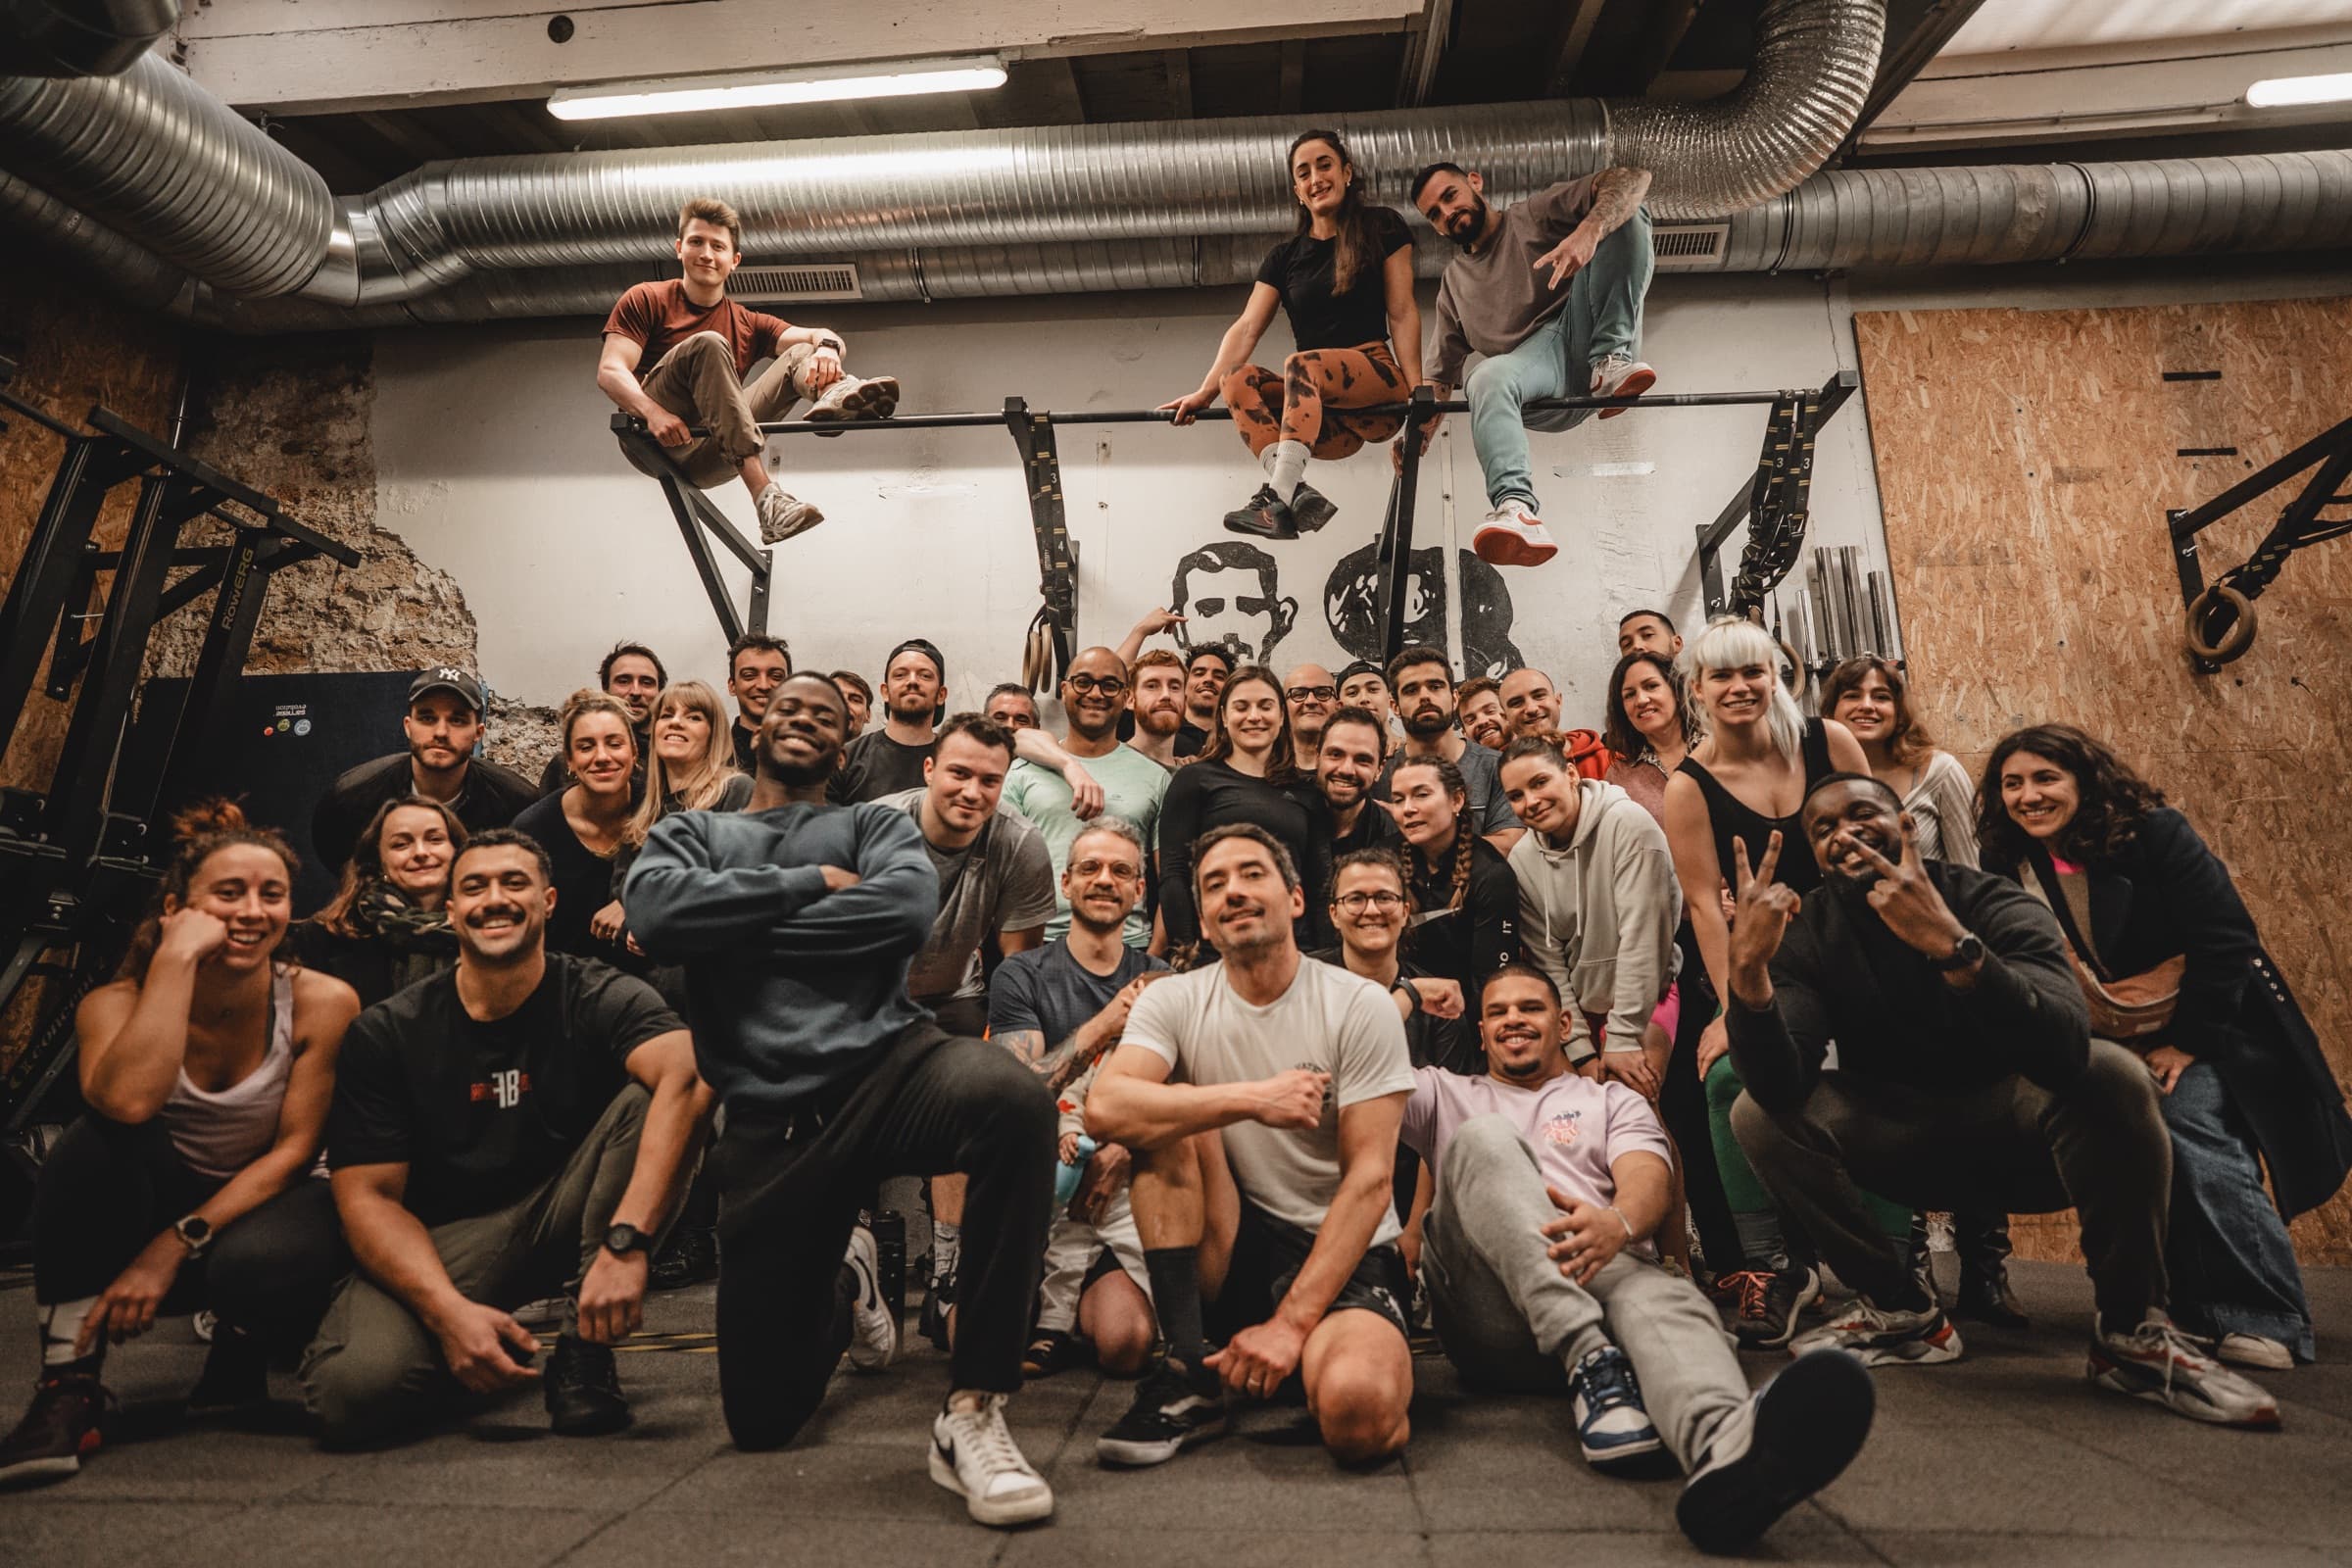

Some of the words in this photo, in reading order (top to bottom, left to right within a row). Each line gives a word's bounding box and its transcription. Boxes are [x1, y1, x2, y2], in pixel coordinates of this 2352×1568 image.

[1776, 457, 1784, 467] 3
[1803, 458, 1811, 469] 3
[1051, 472, 1057, 484] 3
[1058, 540, 1064, 552] 4
[438, 667, 461, 682] NY
[1502, 920, 1512, 933] IT
